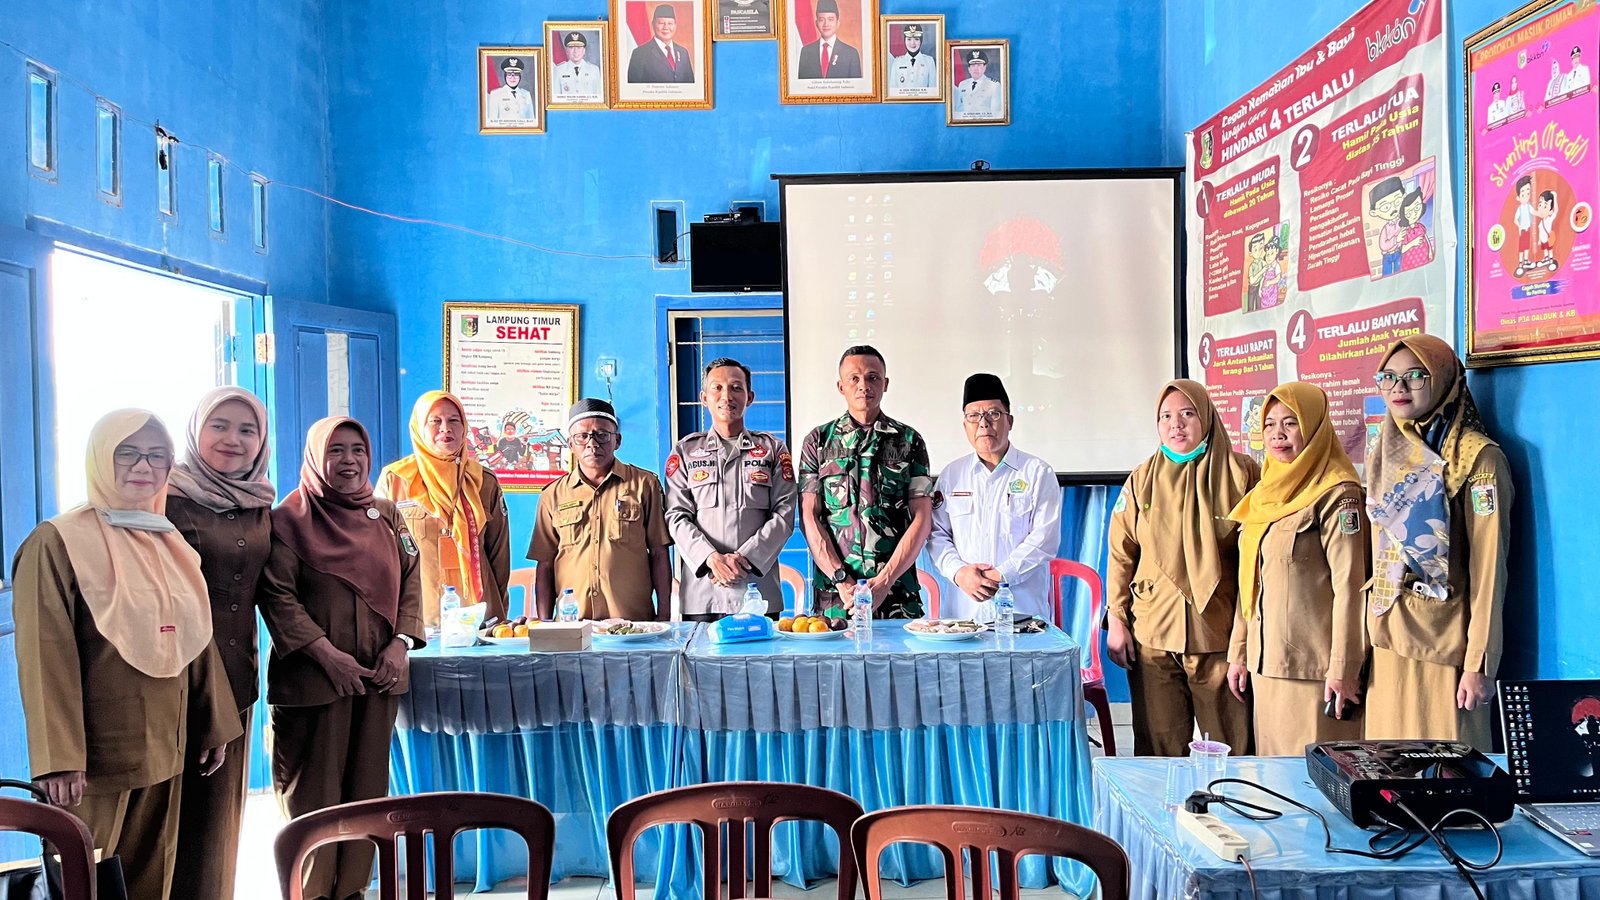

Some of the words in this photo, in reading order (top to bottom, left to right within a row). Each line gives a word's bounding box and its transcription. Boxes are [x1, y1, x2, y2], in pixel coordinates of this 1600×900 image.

[1517, 23, 1543, 43] MASUK
[1316, 50, 1326, 66] &
[1326, 26, 1356, 58] Bayi
[1221, 123, 1268, 162] HINDARI
[1270, 108, 1282, 130] 4
[1283, 68, 1354, 123] TERLALU
[1331, 104, 1386, 142] TERLALU
[1342, 131, 1368, 150] Hamil
[1389, 105, 1420, 122] Usia
[1382, 118, 1418, 139] Tahun
[1296, 129, 1313, 168] 2
[1374, 156, 1404, 172] Tinggi
[1216, 178, 1250, 202] TERLALU
[1250, 164, 1276, 186] MUDA
[1256, 190, 1275, 203] Tahun
[486, 316, 530, 325] LAMPUNG
[532, 316, 561, 326] TIMUR
[1317, 320, 1370, 340] TERLALU
[1371, 308, 1419, 330] BANYAK
[1566, 310, 1576, 318] KB
[496, 326, 550, 340] SEHAT
[1290, 314, 1306, 350] 4
[1338, 336, 1370, 348] Jumlah
[1370, 331, 1390, 343] Anak
[1202, 336, 1210, 366] 3
[1216, 344, 1249, 358] TERLALU
[1250, 338, 1274, 353] RAPAT
[1319, 350, 1364, 362] Dilahirkan
[1365, 345, 1386, 356] Lebih
[1300, 372, 1332, 380] Resikonya
